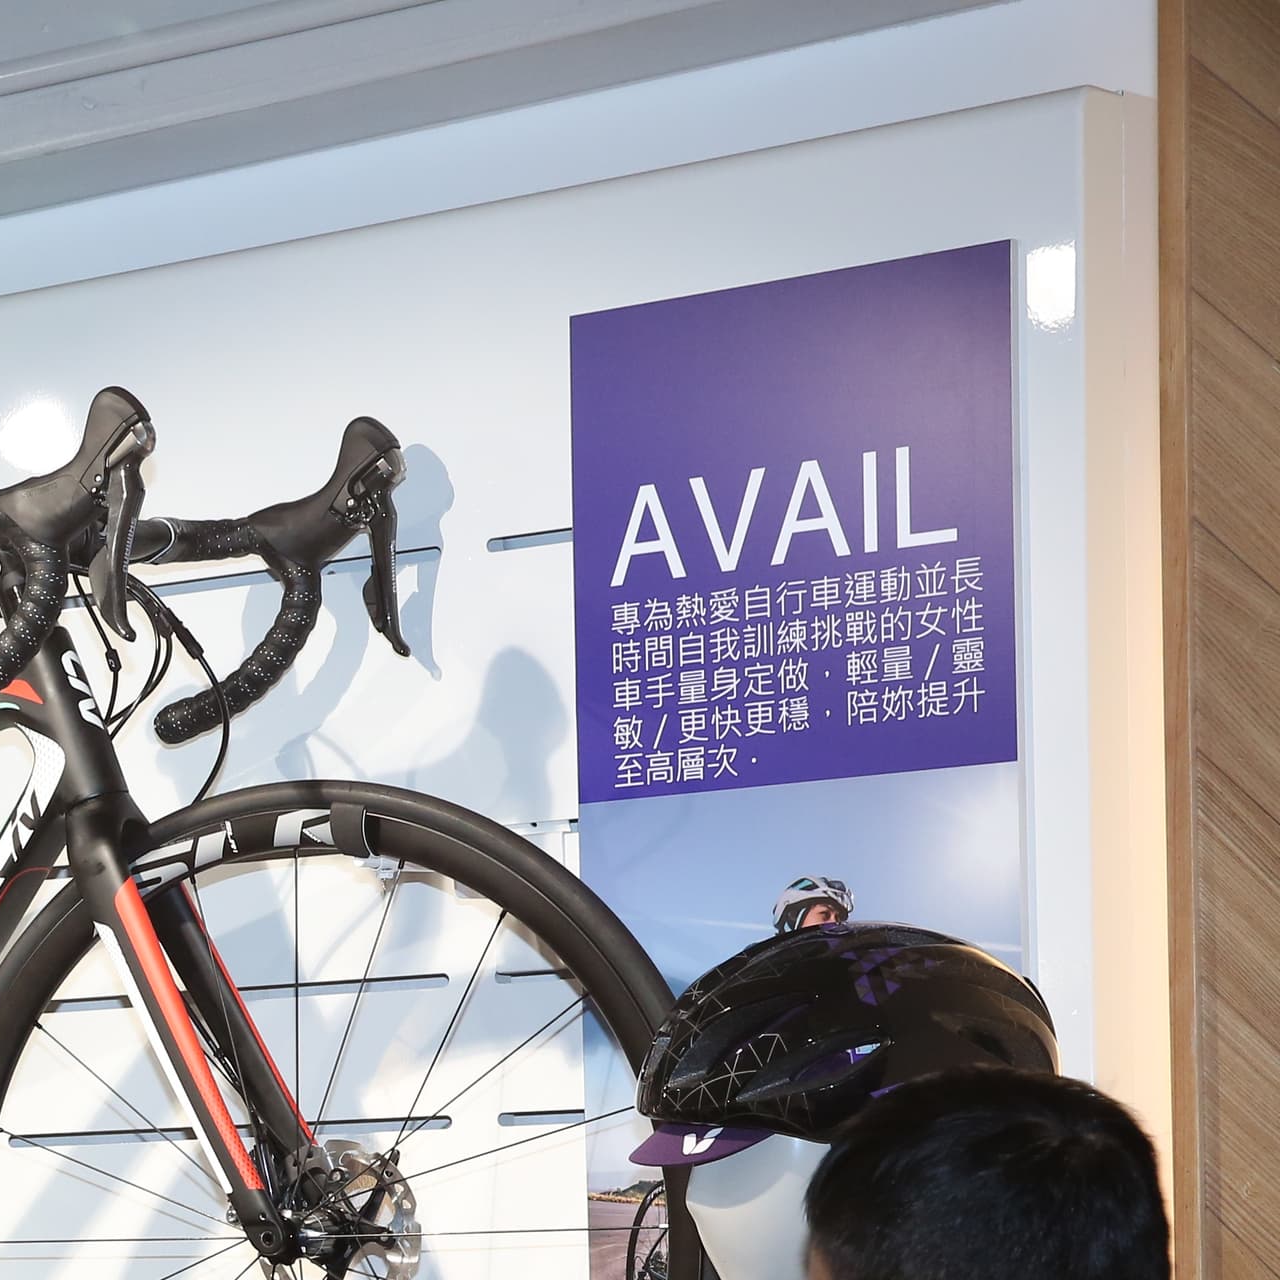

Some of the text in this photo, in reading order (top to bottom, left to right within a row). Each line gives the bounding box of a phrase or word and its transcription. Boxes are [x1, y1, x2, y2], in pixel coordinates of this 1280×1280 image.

[610, 446, 958, 588] AVAIL
[610, 556, 985, 636] 專為熱愛自行車運動並長
[611, 598, 986, 675] 時間自我訓練挑戰的女性
